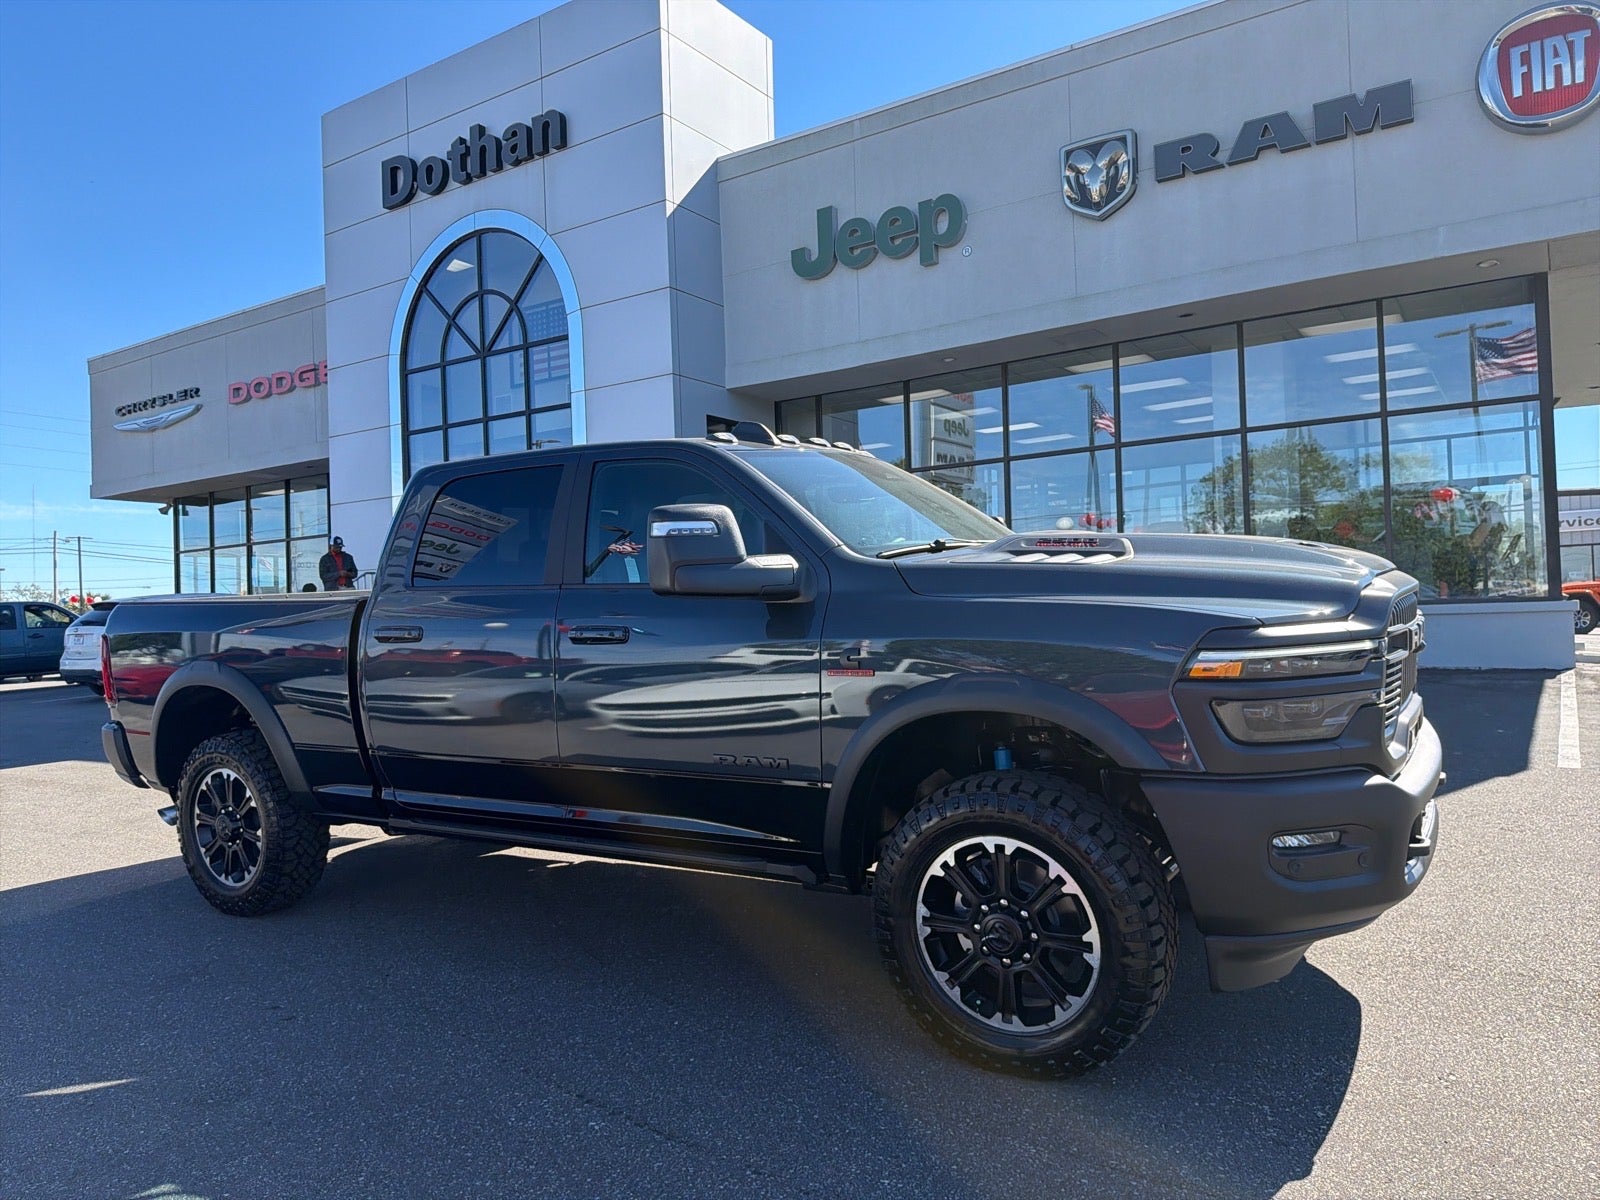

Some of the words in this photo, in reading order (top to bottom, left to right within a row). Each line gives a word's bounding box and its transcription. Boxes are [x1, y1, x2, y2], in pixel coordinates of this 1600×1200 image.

[1510, 29, 1592, 98] FIAT
[381, 109, 567, 210] Dothan
[1153, 79, 1414, 183] RAM
[791, 193, 967, 280] Jeep
[115, 387, 200, 417] CHRYSLER
[713, 753, 790, 769] RAM
